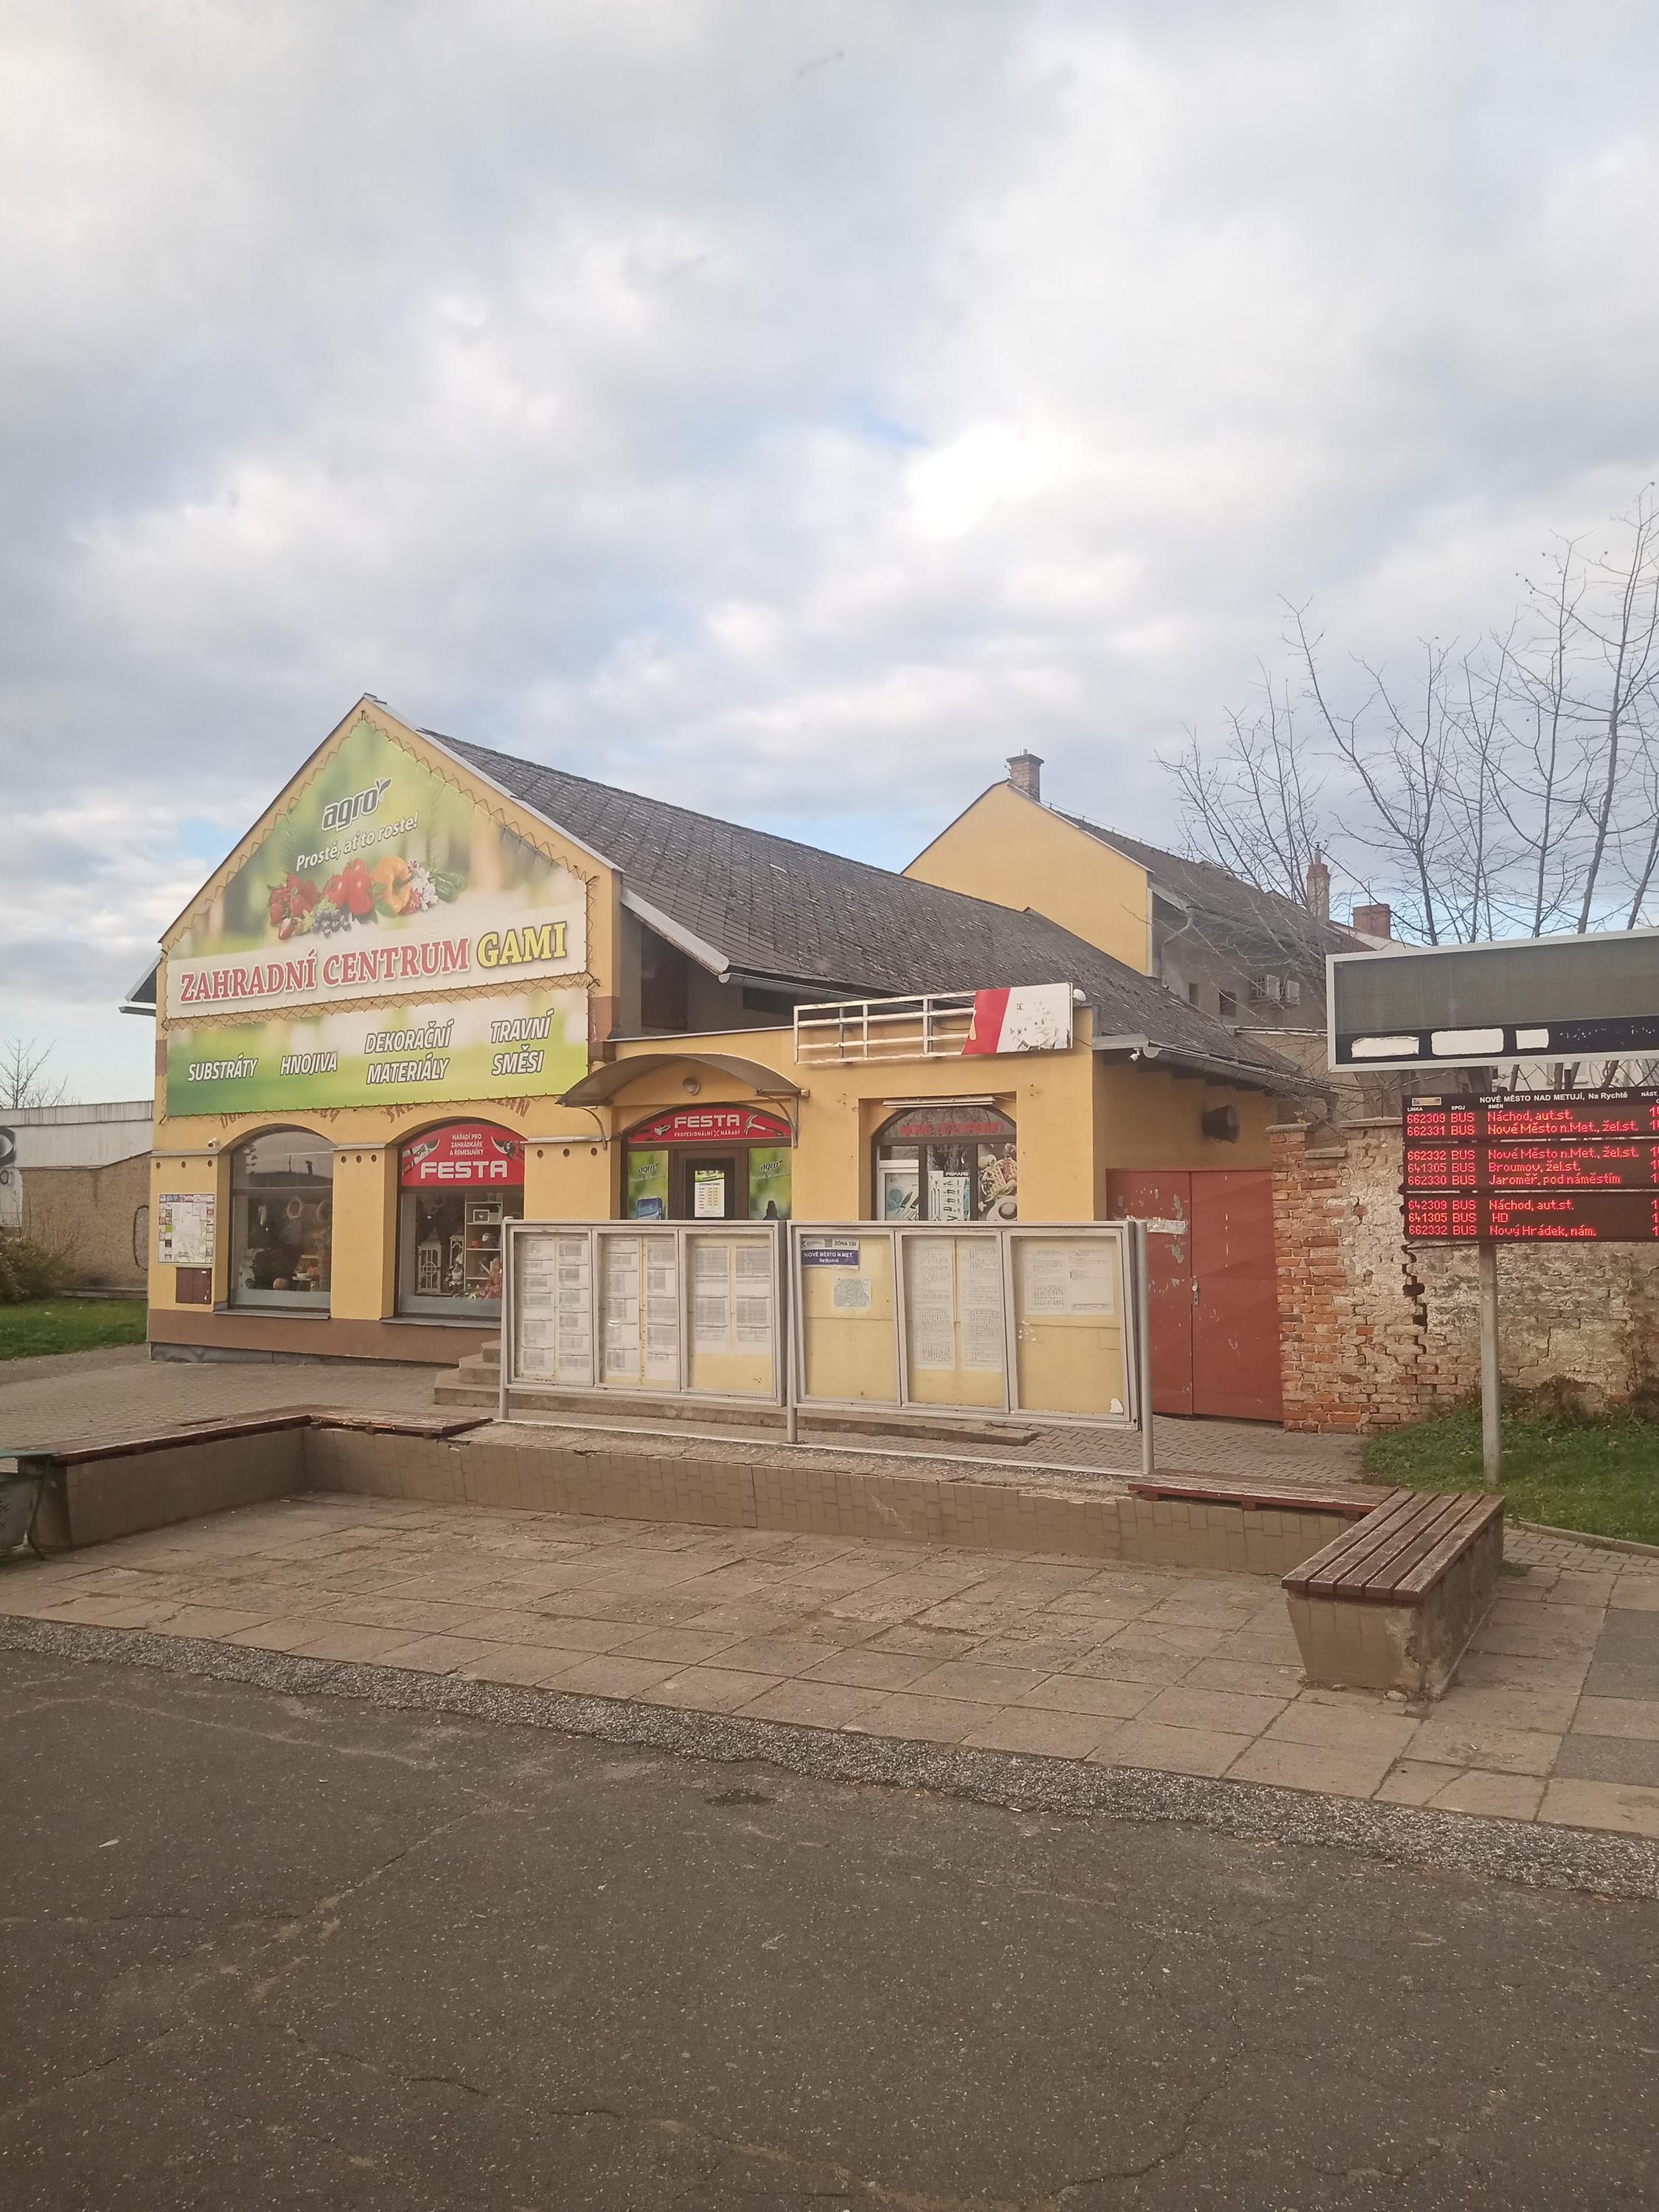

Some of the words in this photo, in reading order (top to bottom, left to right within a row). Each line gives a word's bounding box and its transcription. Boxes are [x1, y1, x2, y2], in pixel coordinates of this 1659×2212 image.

[322, 786, 380, 832] agro
[296, 841, 341, 872] Prostě,
[344, 832, 360, 855] ať
[361, 831, 375, 848] to
[378, 811, 419, 842] roste!
[180, 948, 316, 1003] ZAHRADNÍ
[323, 937, 469, 986] CENTRUM
[477, 921, 567, 967] GAMI
[491, 1008, 554, 1043] TRAVNÍ
[365, 1018, 454, 1054] DEKORAČNÍ
[187, 1053, 258, 1082] SUBSTRÁTY
[280, 1052, 338, 1076] HNOJIVA
[366, 1052, 450, 1085] MATERIÁLY
[492, 1045, 544, 1075] SMĚSI
[1479, 1095, 1501, 1103] NOVÉ
[1503, 1094, 1531, 1102] MĚSTO
[1554, 1092, 1585, 1101] METUJÍ,
[1601, 1091, 1627, 1101] Rychtě
[674, 1114, 740, 1129] FESTA
[1407, 1113, 1445, 1124] 662309
[1450, 1112, 1475, 1122] BUS
[1488, 1110, 1532, 1122] Náchod,
[1535, 1109, 1573, 1121] aut.st.
[1407, 1126, 1445, 1136] 662331
[1450, 1125, 1475, 1135] BUS
[1488, 1122, 1518, 1135] Nové
[1520, 1121, 1557, 1133] Město
[1559, 1121, 1600, 1133] n.Met.,
[1602, 1120, 1638, 1133] žel.st.
[1408, 1150, 1447, 1161] 662332
[1451, 1150, 1475, 1160] BUS
[1488, 1147, 1518, 1160] Nové
[1520, 1147, 1557, 1159] Město
[1560, 1147, 1600, 1158] n.Met.,
[1602, 1146, 1639, 1158] žel.st.
[421, 1161, 507, 1179] FESTA
[1408, 1163, 1447, 1173] 641305
[1452, 1162, 1475, 1172] BUS
[1489, 1161, 1543, 1173] Broumov,
[1545, 1160, 1581, 1172] žel.st.
[1408, 1175, 1447, 1185] 662330
[1452, 1175, 1475, 1185] BUS
[1489, 1173, 1540, 1186] Jaroměř,
[1543, 1174, 1563, 1186] pod
[1566, 1172, 1621, 1184] náměstím
[1408, 1200, 1447, 1210] 642309
[1453, 1200, 1476, 1210] BUS
[1489, 1198, 1534, 1211] Náchod,
[1537, 1200, 1574, 1210] aut.st.
[1408, 1213, 1447, 1222] 641305
[1453, 1213, 1476, 1222] BUS
[1492, 1213, 1508, 1222] HD
[1409, 1225, 1447, 1235] 662332
[1453, 1225, 1476, 1235] BUS
[1489, 1224, 1519, 1237] Nový
[1523, 1224, 1568, 1237] Hrádek,
[1571, 1224, 1596, 1236] nám.
